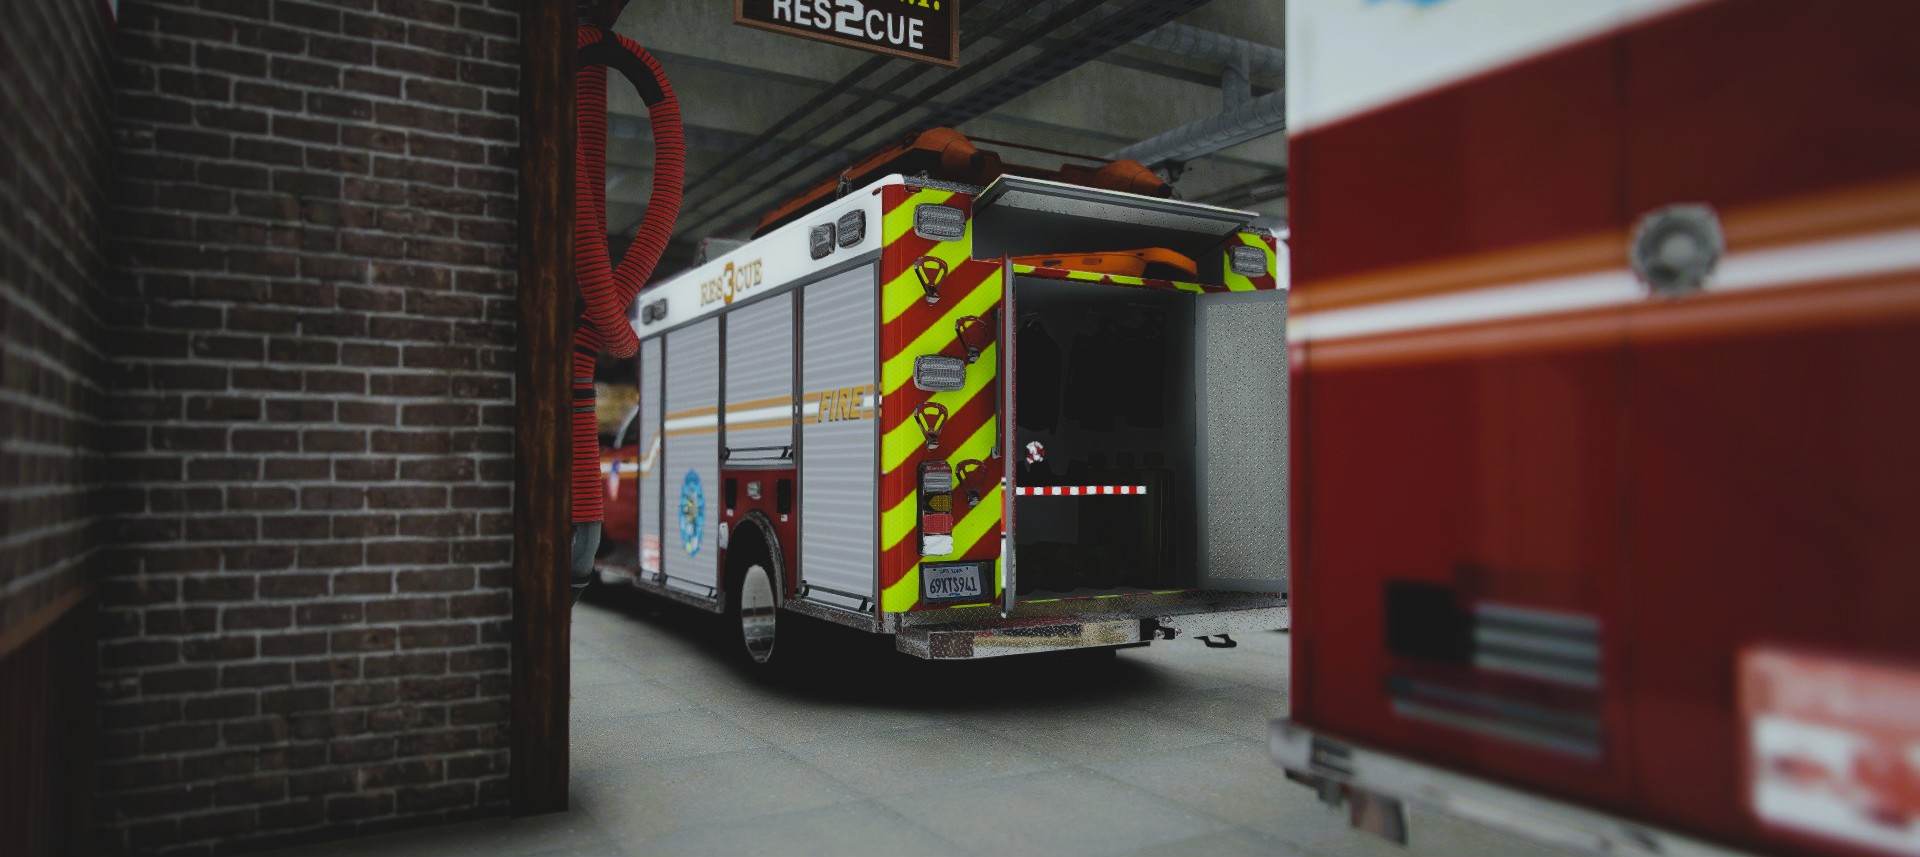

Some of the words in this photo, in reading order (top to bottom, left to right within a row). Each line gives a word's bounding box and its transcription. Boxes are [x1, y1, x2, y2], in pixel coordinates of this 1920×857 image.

[773, 0, 924, 50] RES2CUE
[701, 259, 762, 306] RES3CUE
[817, 386, 865, 423] FIRE
[929, 576, 977, 594] 69XTS941
